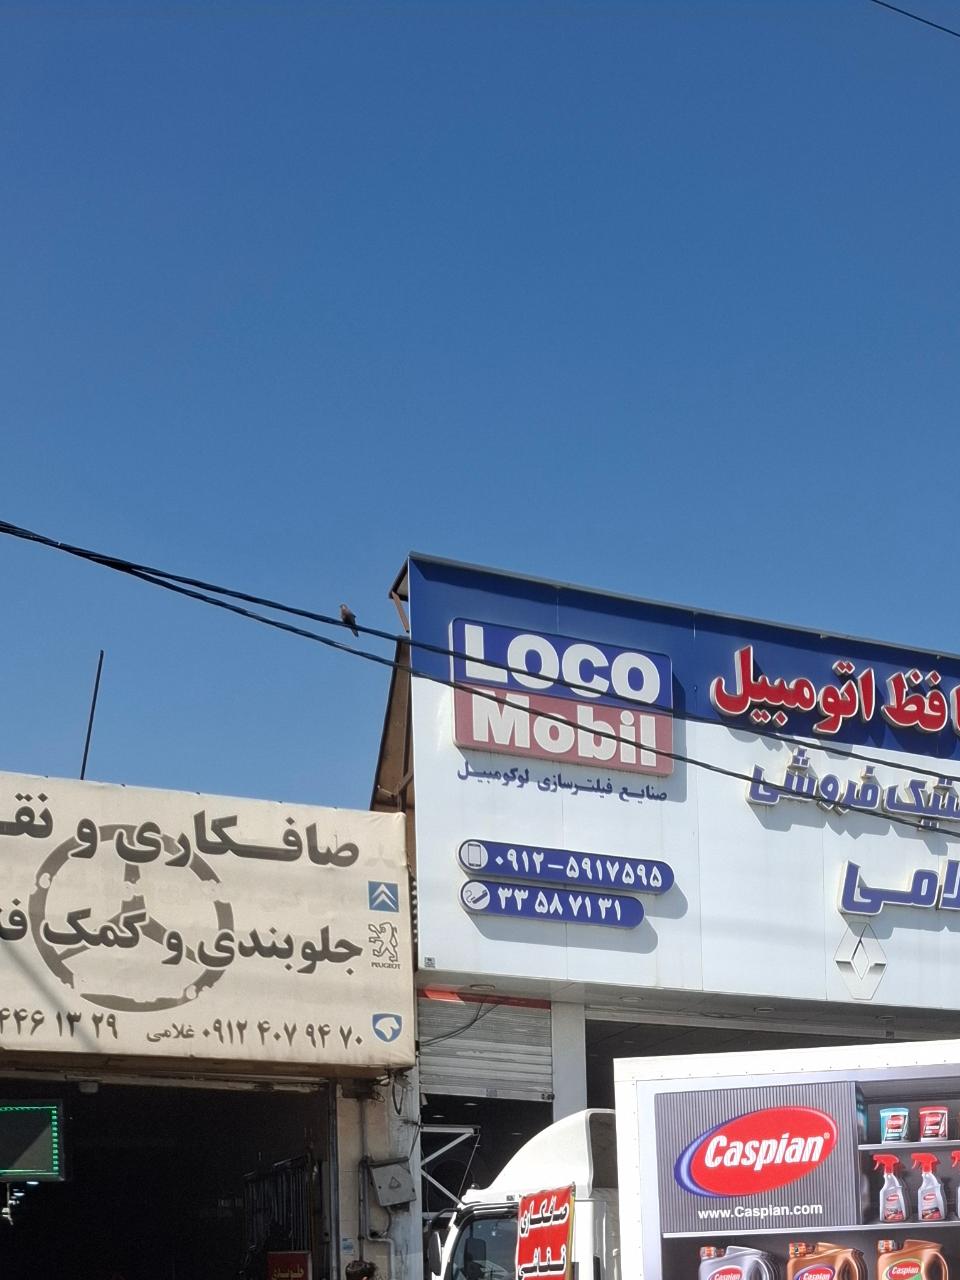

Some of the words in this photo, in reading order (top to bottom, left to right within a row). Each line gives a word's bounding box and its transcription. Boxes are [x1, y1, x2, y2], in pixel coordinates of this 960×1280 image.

[464, 624, 660, 705] LOCO
[711, 645, 875, 735] اتومبیل
[471, 688, 656, 767] Mobil
[457, 762, 530, 788] لوکومبیل
[619, 782, 667, 802] صنایع
[748, 747, 881, 815] فروشی
[69, 818, 99, 859] و
[115, 809, 360, 868] صافکاری
[162, 930, 185, 965] و
[198, 925, 363, 976] جلوبندی
[146, 1022, 195, 1043] غلامی
[704, 1132, 823, 1171] Caspian
[697, 1203, 823, 1220] www.Caspian.com
[892, 1266, 919, 1276] Caspian
